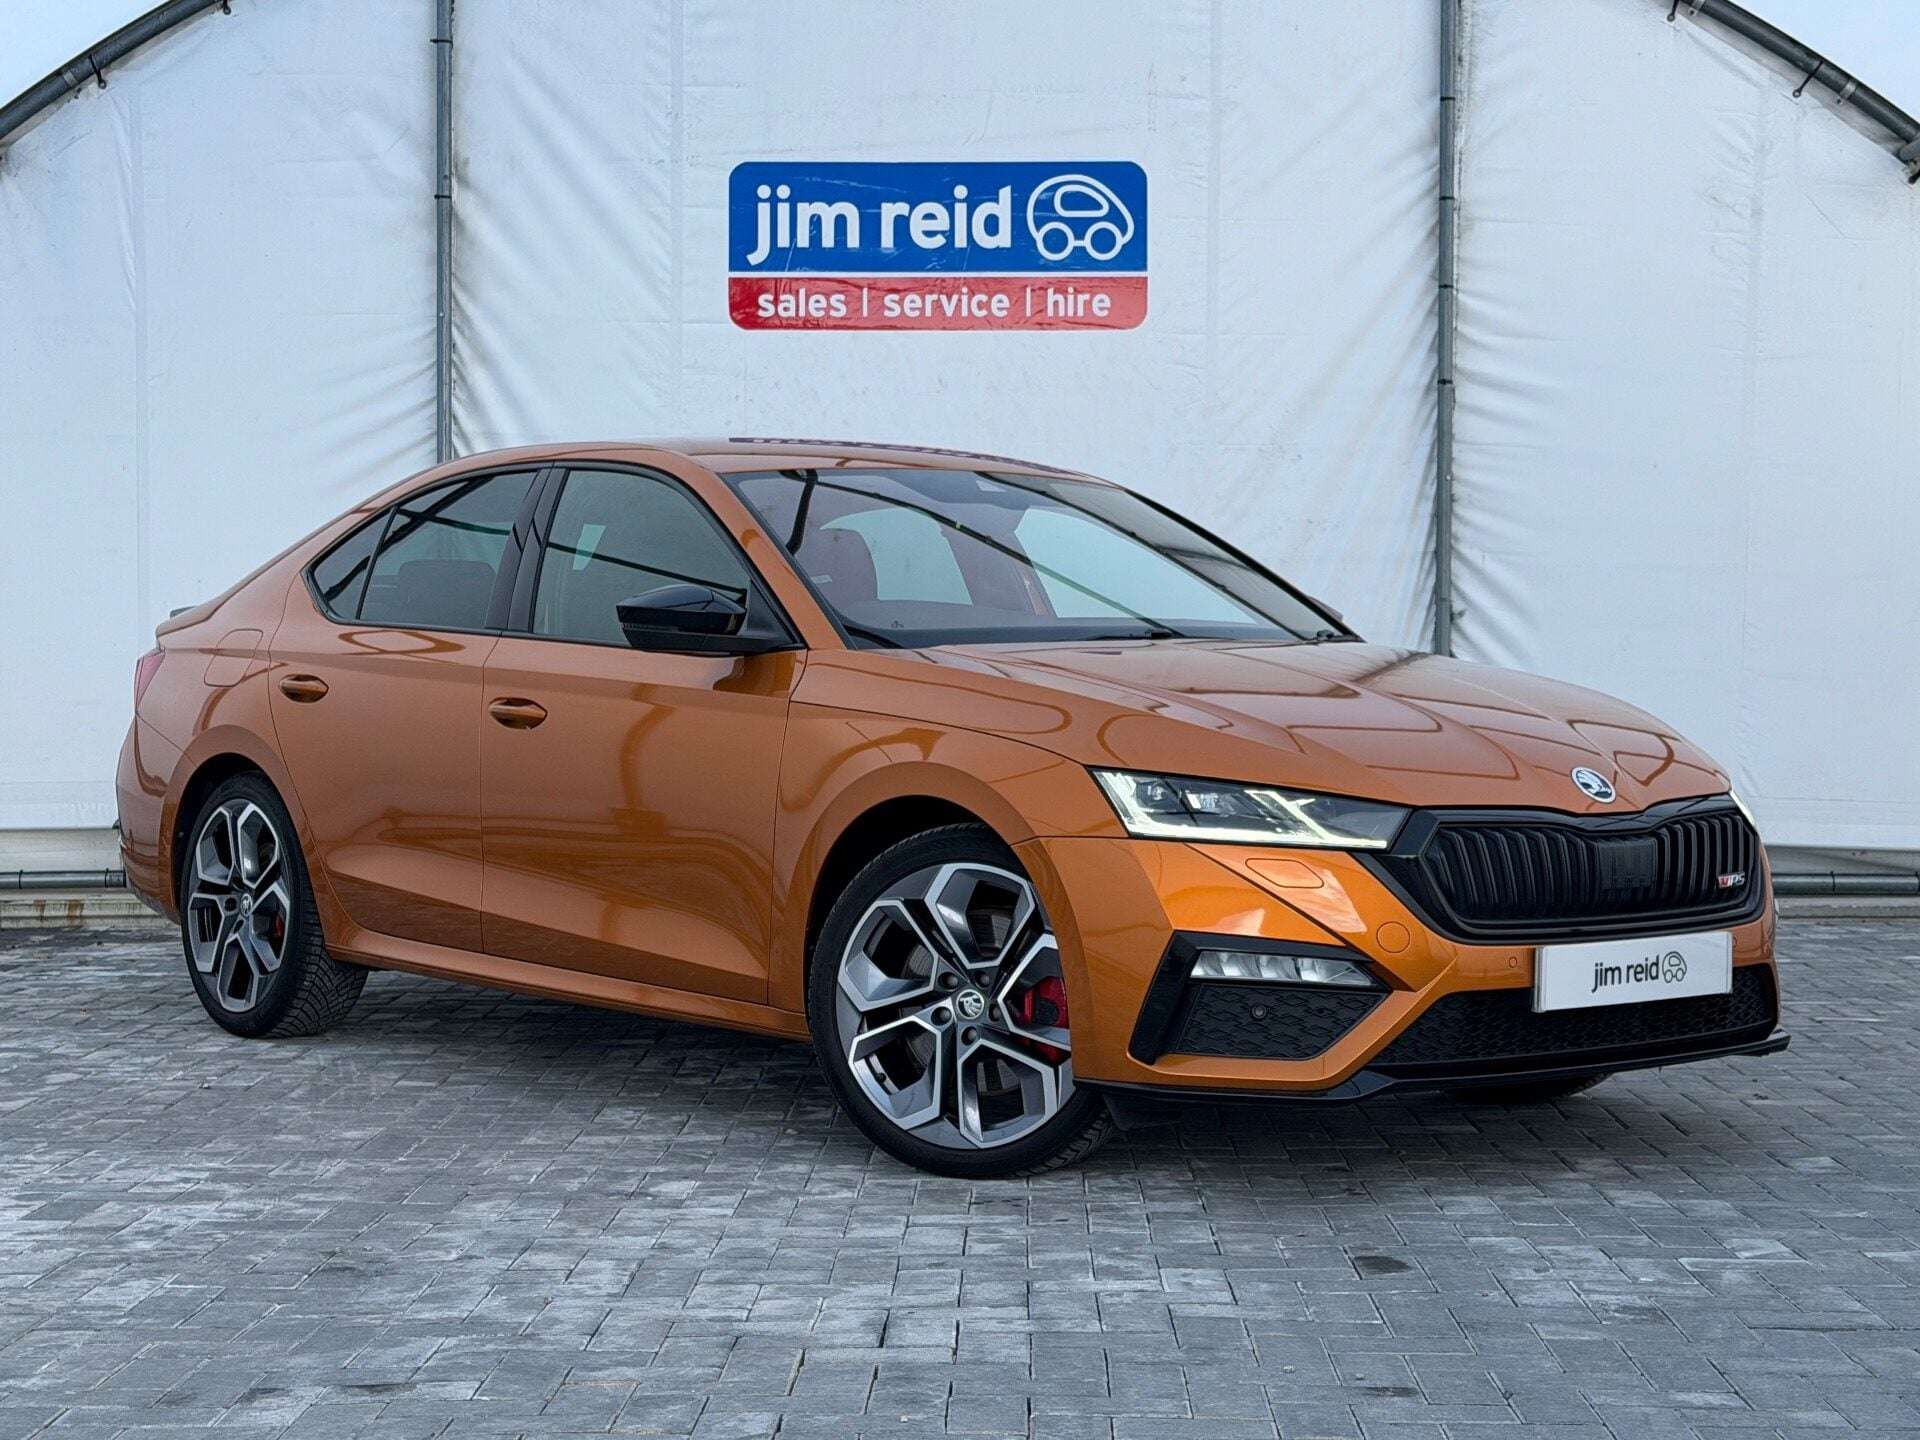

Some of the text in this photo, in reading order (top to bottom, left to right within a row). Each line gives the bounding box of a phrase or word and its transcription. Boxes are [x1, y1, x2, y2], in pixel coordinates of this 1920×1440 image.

[746, 184, 1012, 266] jim reid
[757, 286, 1112, 318] sales service hire
[1591, 954, 1660, 994] jim reid
